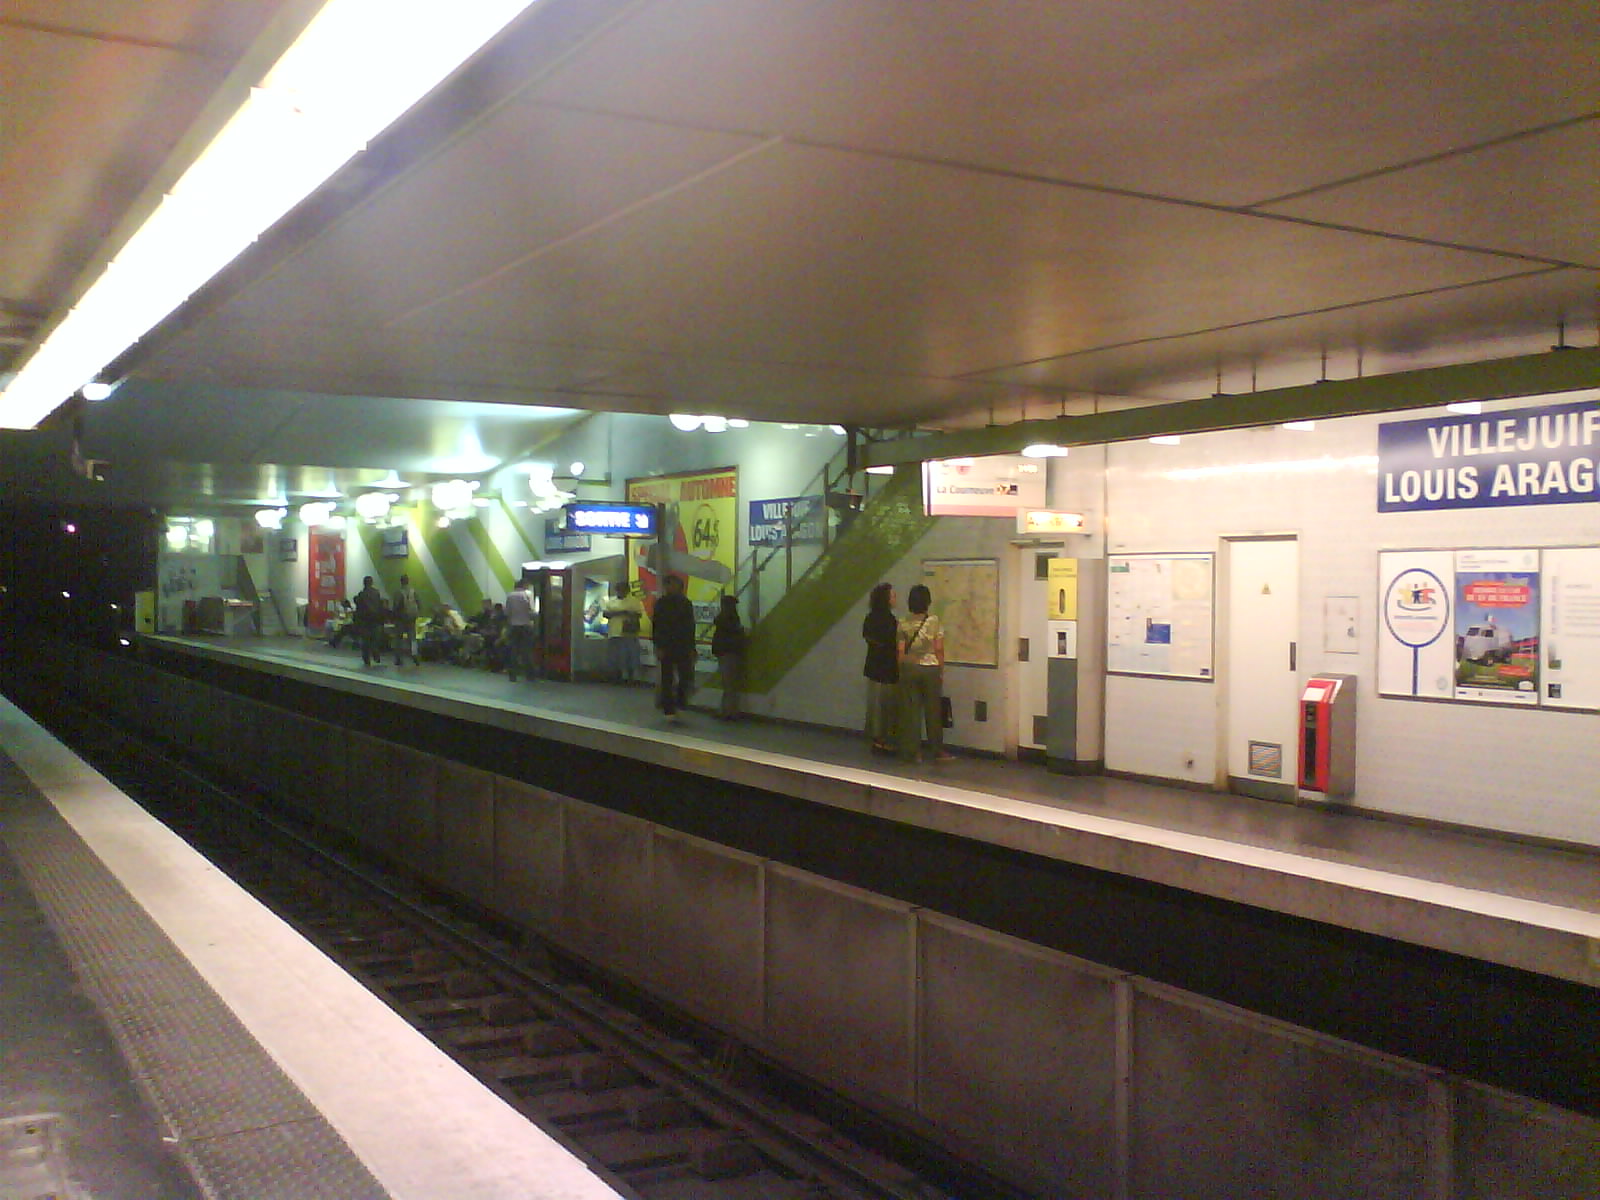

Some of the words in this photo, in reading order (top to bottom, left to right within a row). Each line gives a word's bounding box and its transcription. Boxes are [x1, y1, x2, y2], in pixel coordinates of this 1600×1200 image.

[1427, 409, 1600, 459] VILLEJUIF
[1385, 465, 1480, 503] LOUIS
[1489, 456, 1600, 497] ARAG
